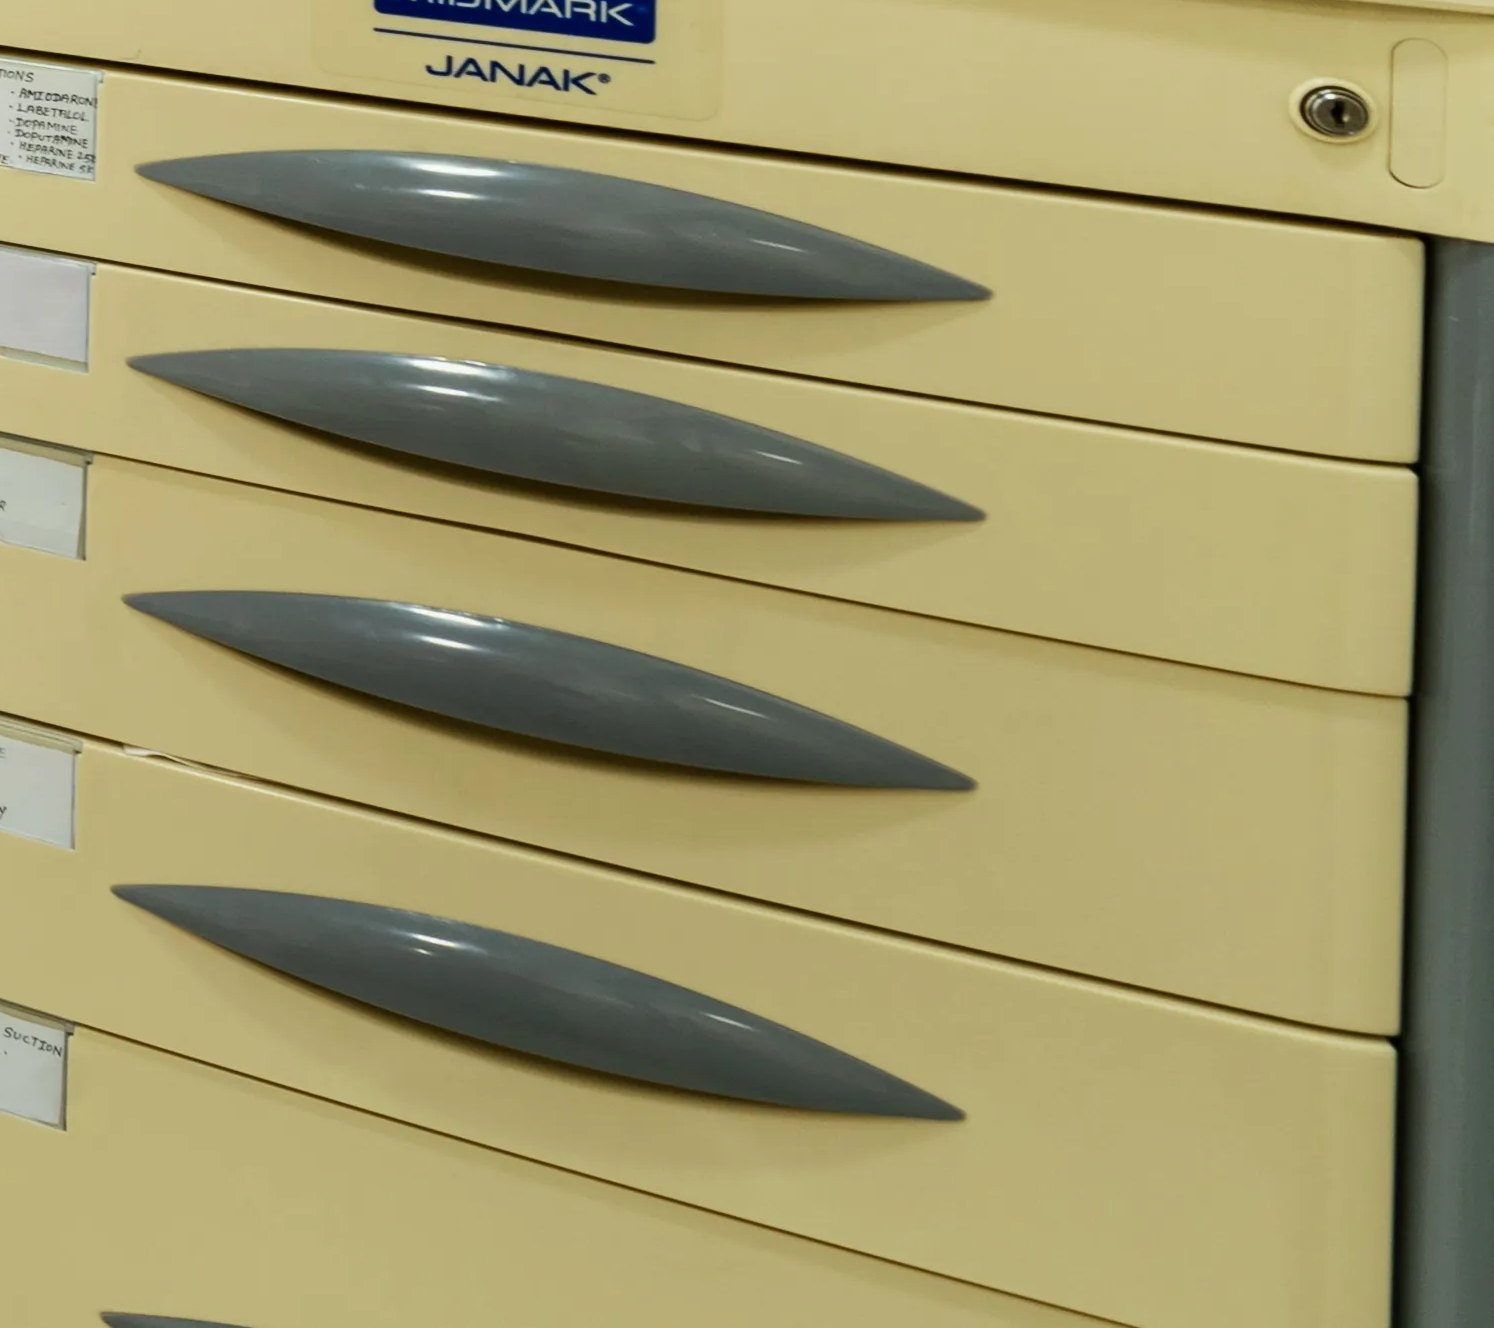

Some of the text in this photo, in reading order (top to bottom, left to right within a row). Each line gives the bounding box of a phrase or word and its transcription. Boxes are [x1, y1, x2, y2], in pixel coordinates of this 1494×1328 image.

[16, 103, 90, 122] LABETALOL
[14, 117, 78, 135] DOPAMINE
[19, 141, 73, 160] HEPARINE
[25, 155, 76, 171] HEPARINE
[3, 1026, 63, 1058] SUCTION
